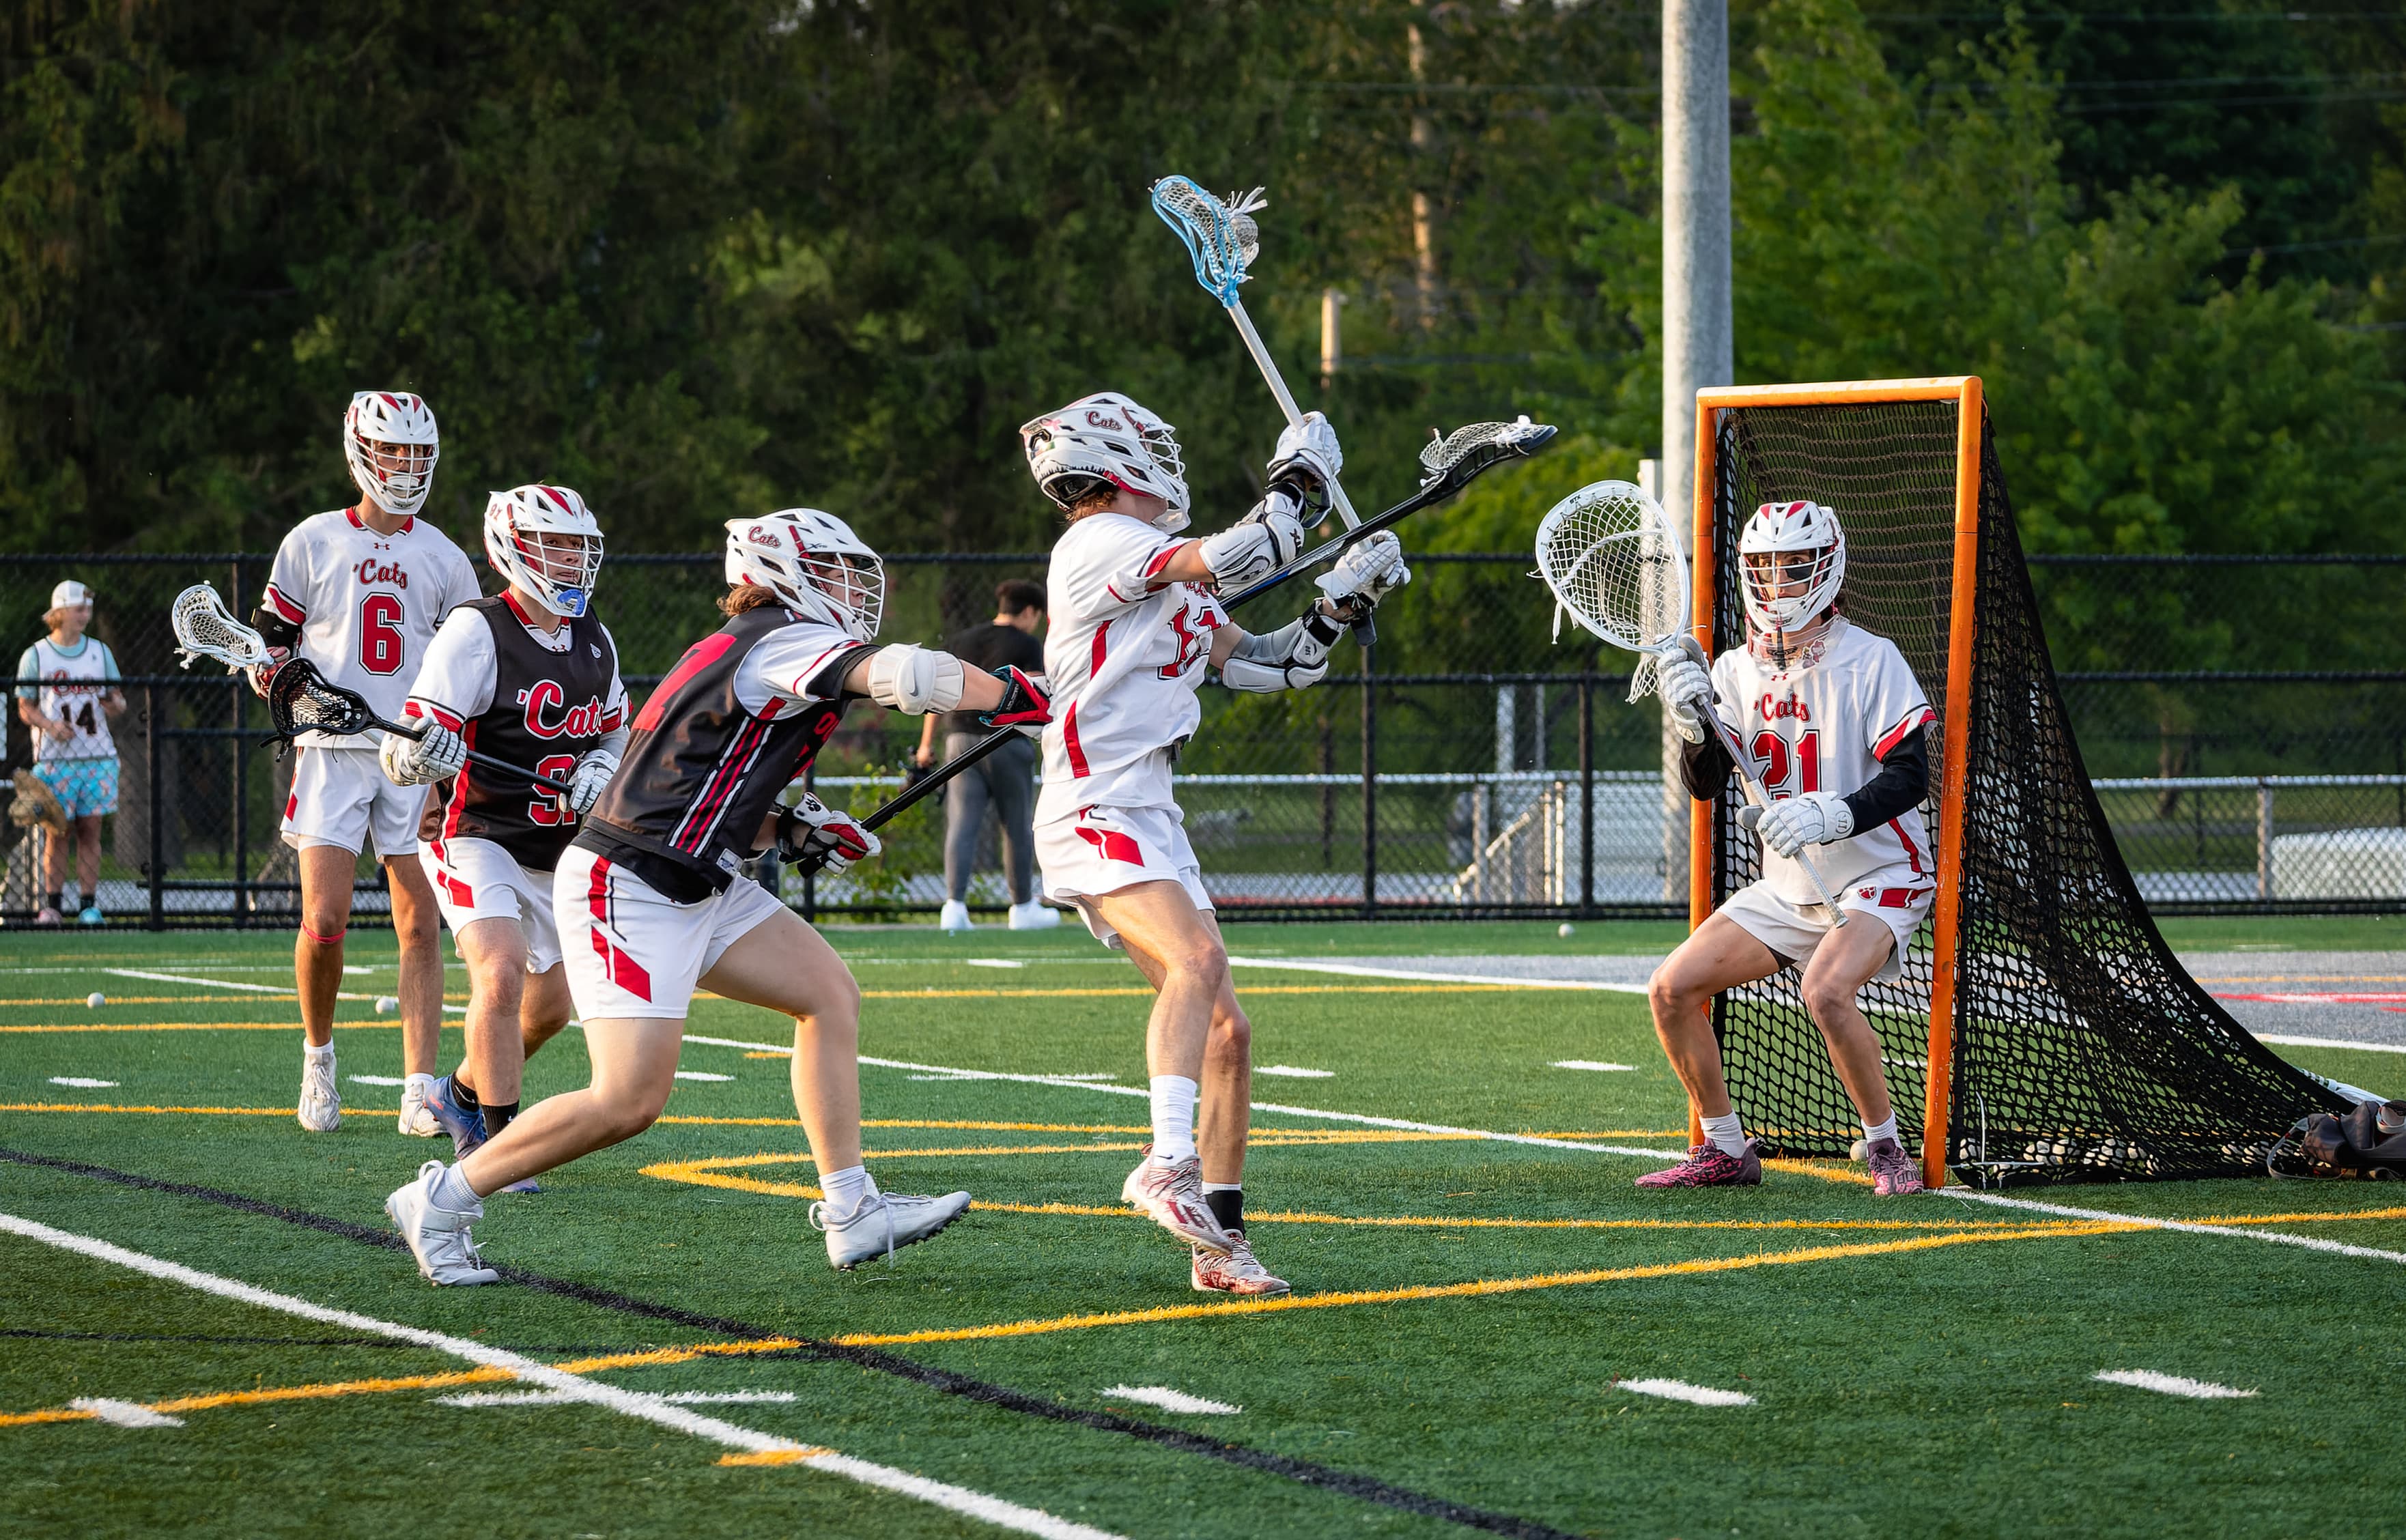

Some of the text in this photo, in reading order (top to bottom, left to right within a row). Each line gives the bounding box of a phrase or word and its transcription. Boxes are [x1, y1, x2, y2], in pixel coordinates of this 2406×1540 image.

[1570, 494, 1581, 504] STX
[358, 591, 405, 676] 6
[60, 701, 97, 735] 14
[1749, 729, 1822, 800] 21
